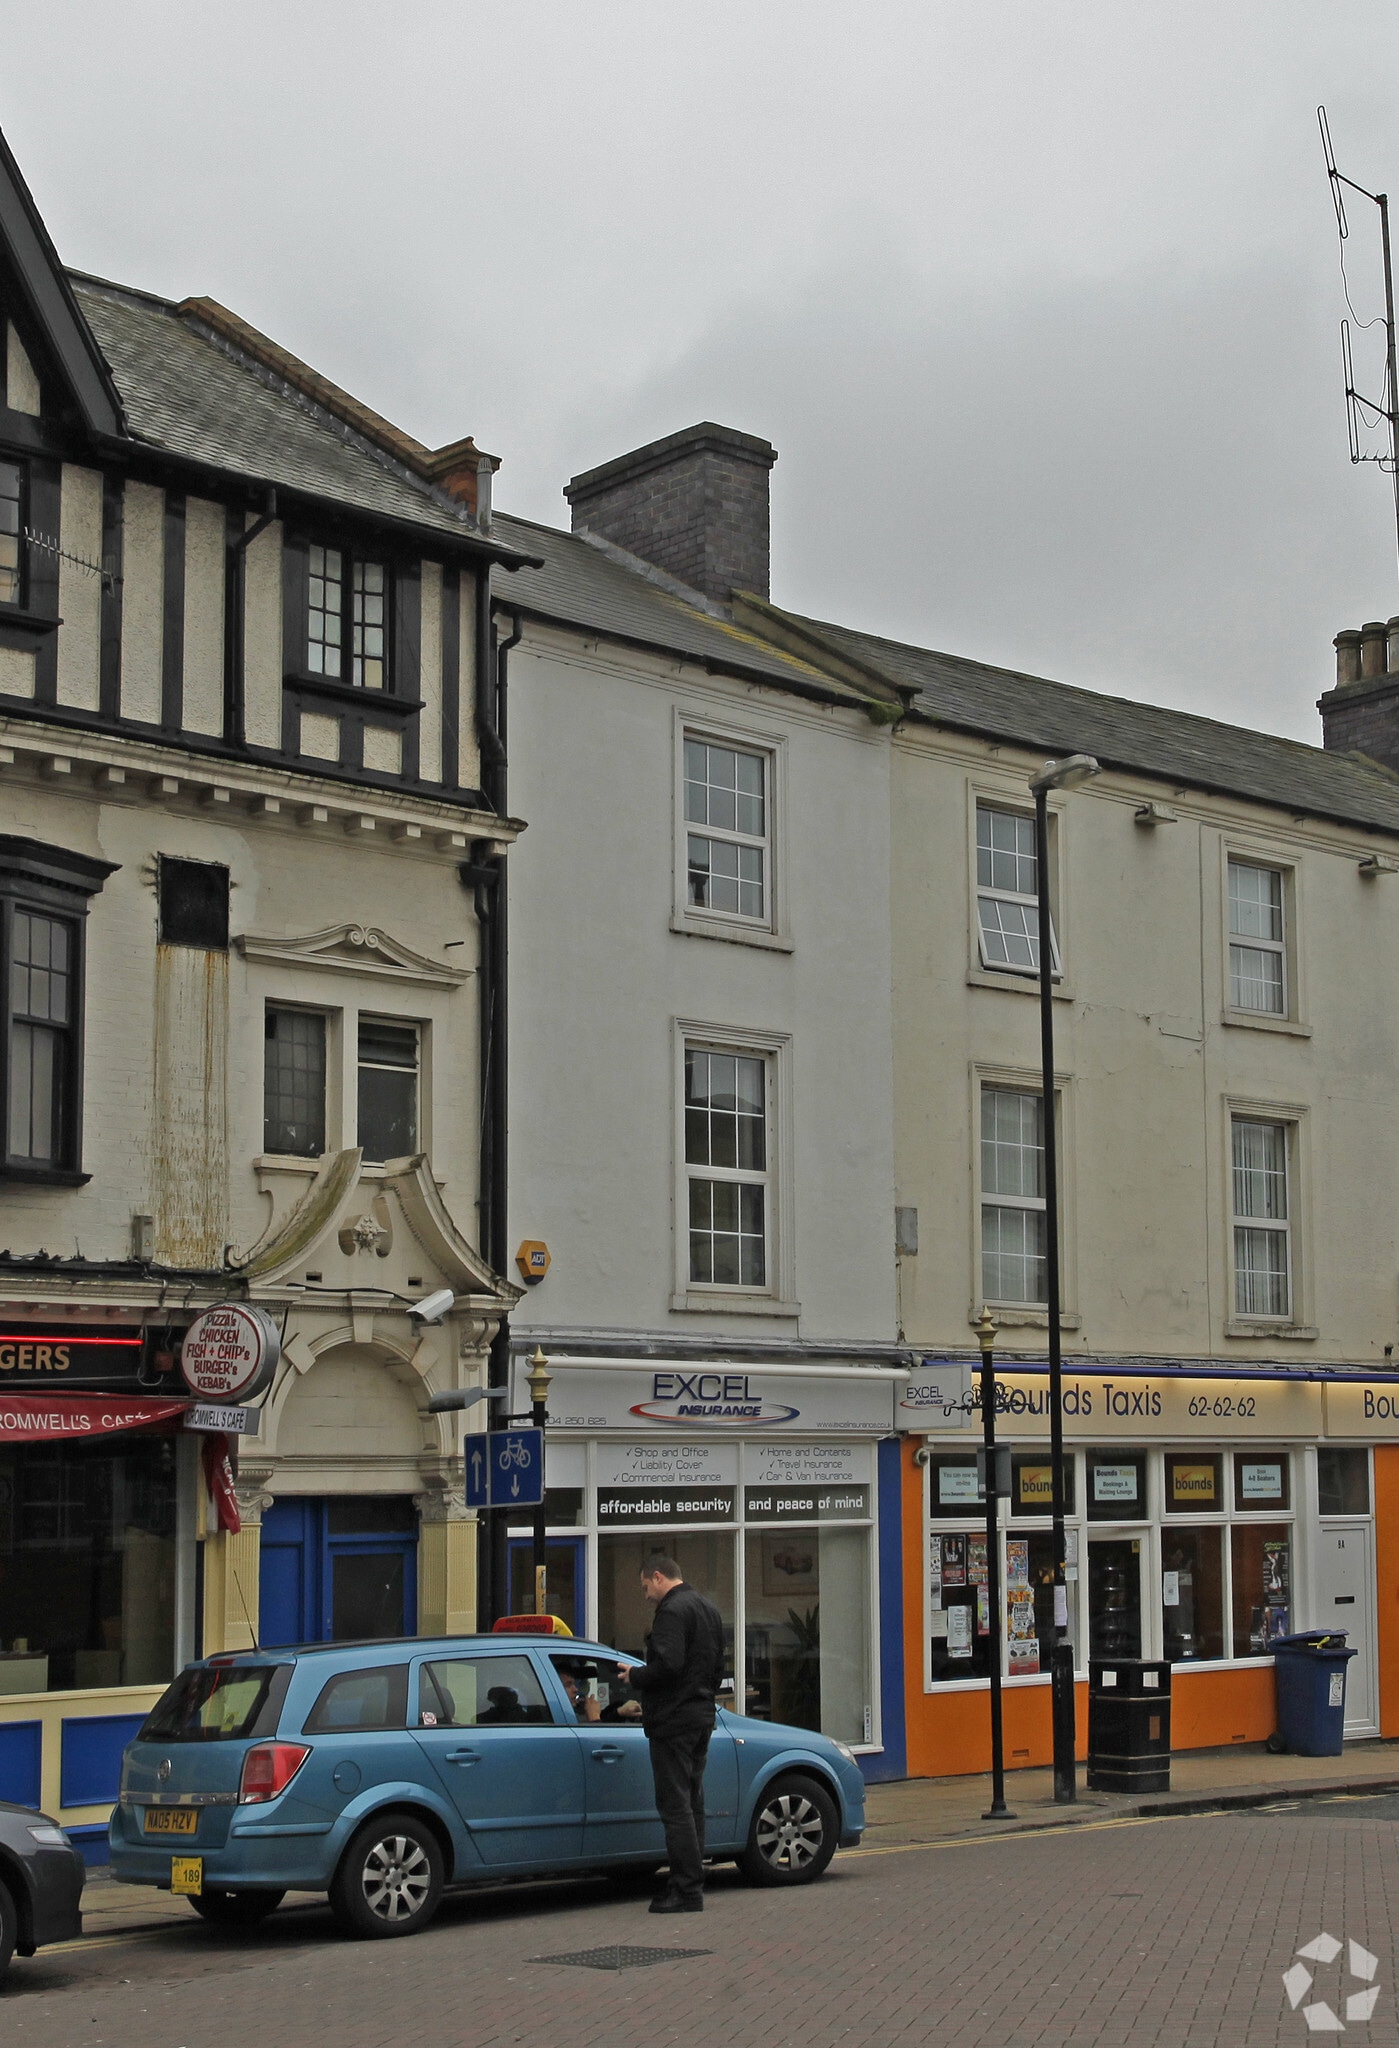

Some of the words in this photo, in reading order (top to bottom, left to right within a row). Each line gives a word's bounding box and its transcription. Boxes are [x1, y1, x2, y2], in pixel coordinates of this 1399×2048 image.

[532, 1254, 545, 1263] ADT
[199, 1328, 240, 1344] CHICKEN
[186, 1343, 207, 1359] FISH
[0, 1345, 70, 1371] GERS
[653, 1373, 763, 1401] EXCEL
[906, 1386, 944, 1399] EXCEL
[1103, 1383, 1162, 1416] Taxis
[1188, 1396, 1256, 1417] 62-62-62
[678, 1404, 762, 1416] INSURANCE
[565, 1416, 585, 1425] 250
[587, 1416, 607, 1425] 625
[634, 1447, 659, 1458] Shop
[661, 1447, 679, 1457] and
[682, 1446, 709, 1457] Office
[767, 1448, 792, 1457] Home
[795, 1447, 811, 1456] and
[813, 1447, 852, 1457] Contents
[640, 1460, 673, 1471] Liability
[676, 1460, 704, 1470] Cover
[777, 1459, 801, 1469] Travel
[804, 1460, 843, 1469] Insurance
[621, 1472, 676, 1483] Commercial
[678, 1472, 722, 1482] Insurance
[766, 1471, 783, 1481] Car
[785, 1471, 793, 1481] &
[796, 1471, 812, 1480] Van
[814, 1470, 853, 1480] Insurance
[1175, 1478, 1213, 1490] bounds
[600, 1499, 671, 1514] affordable
[676, 1498, 732, 1513] security
[748, 1497, 772, 1510] and
[776, 1499, 814, 1512] peace
[818, 1496, 831, 1509] of
[835, 1495, 863, 1509] mind
[184, 1869, 200, 1882] 189
